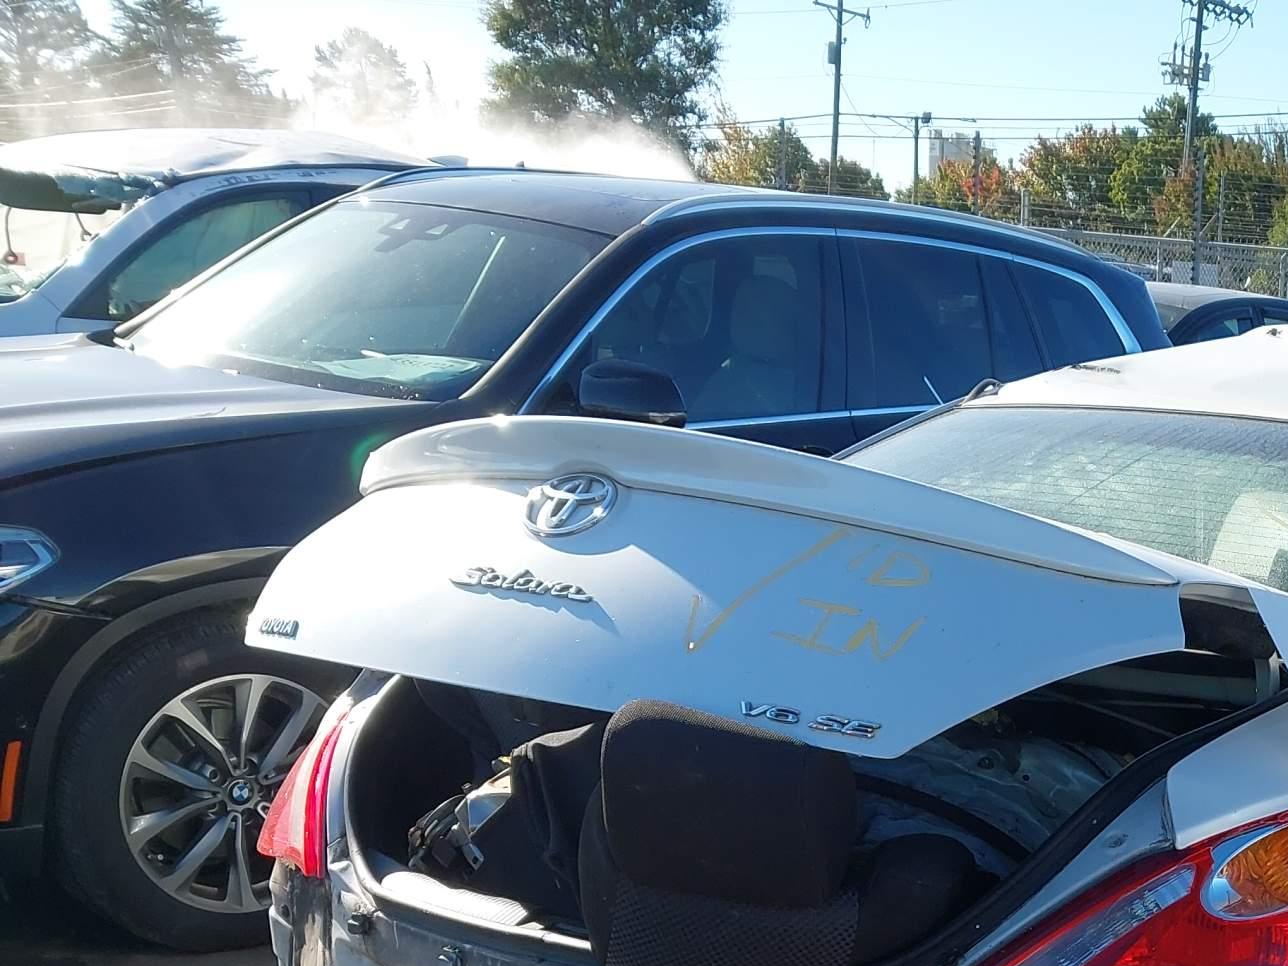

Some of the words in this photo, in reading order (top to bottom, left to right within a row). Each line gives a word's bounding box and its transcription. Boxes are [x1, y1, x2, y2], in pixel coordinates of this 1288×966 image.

[449, 566, 594, 603] Solara
[770, 597, 927, 662] IN
[740, 699, 801, 724] V6
[807, 713, 882, 740] SE
